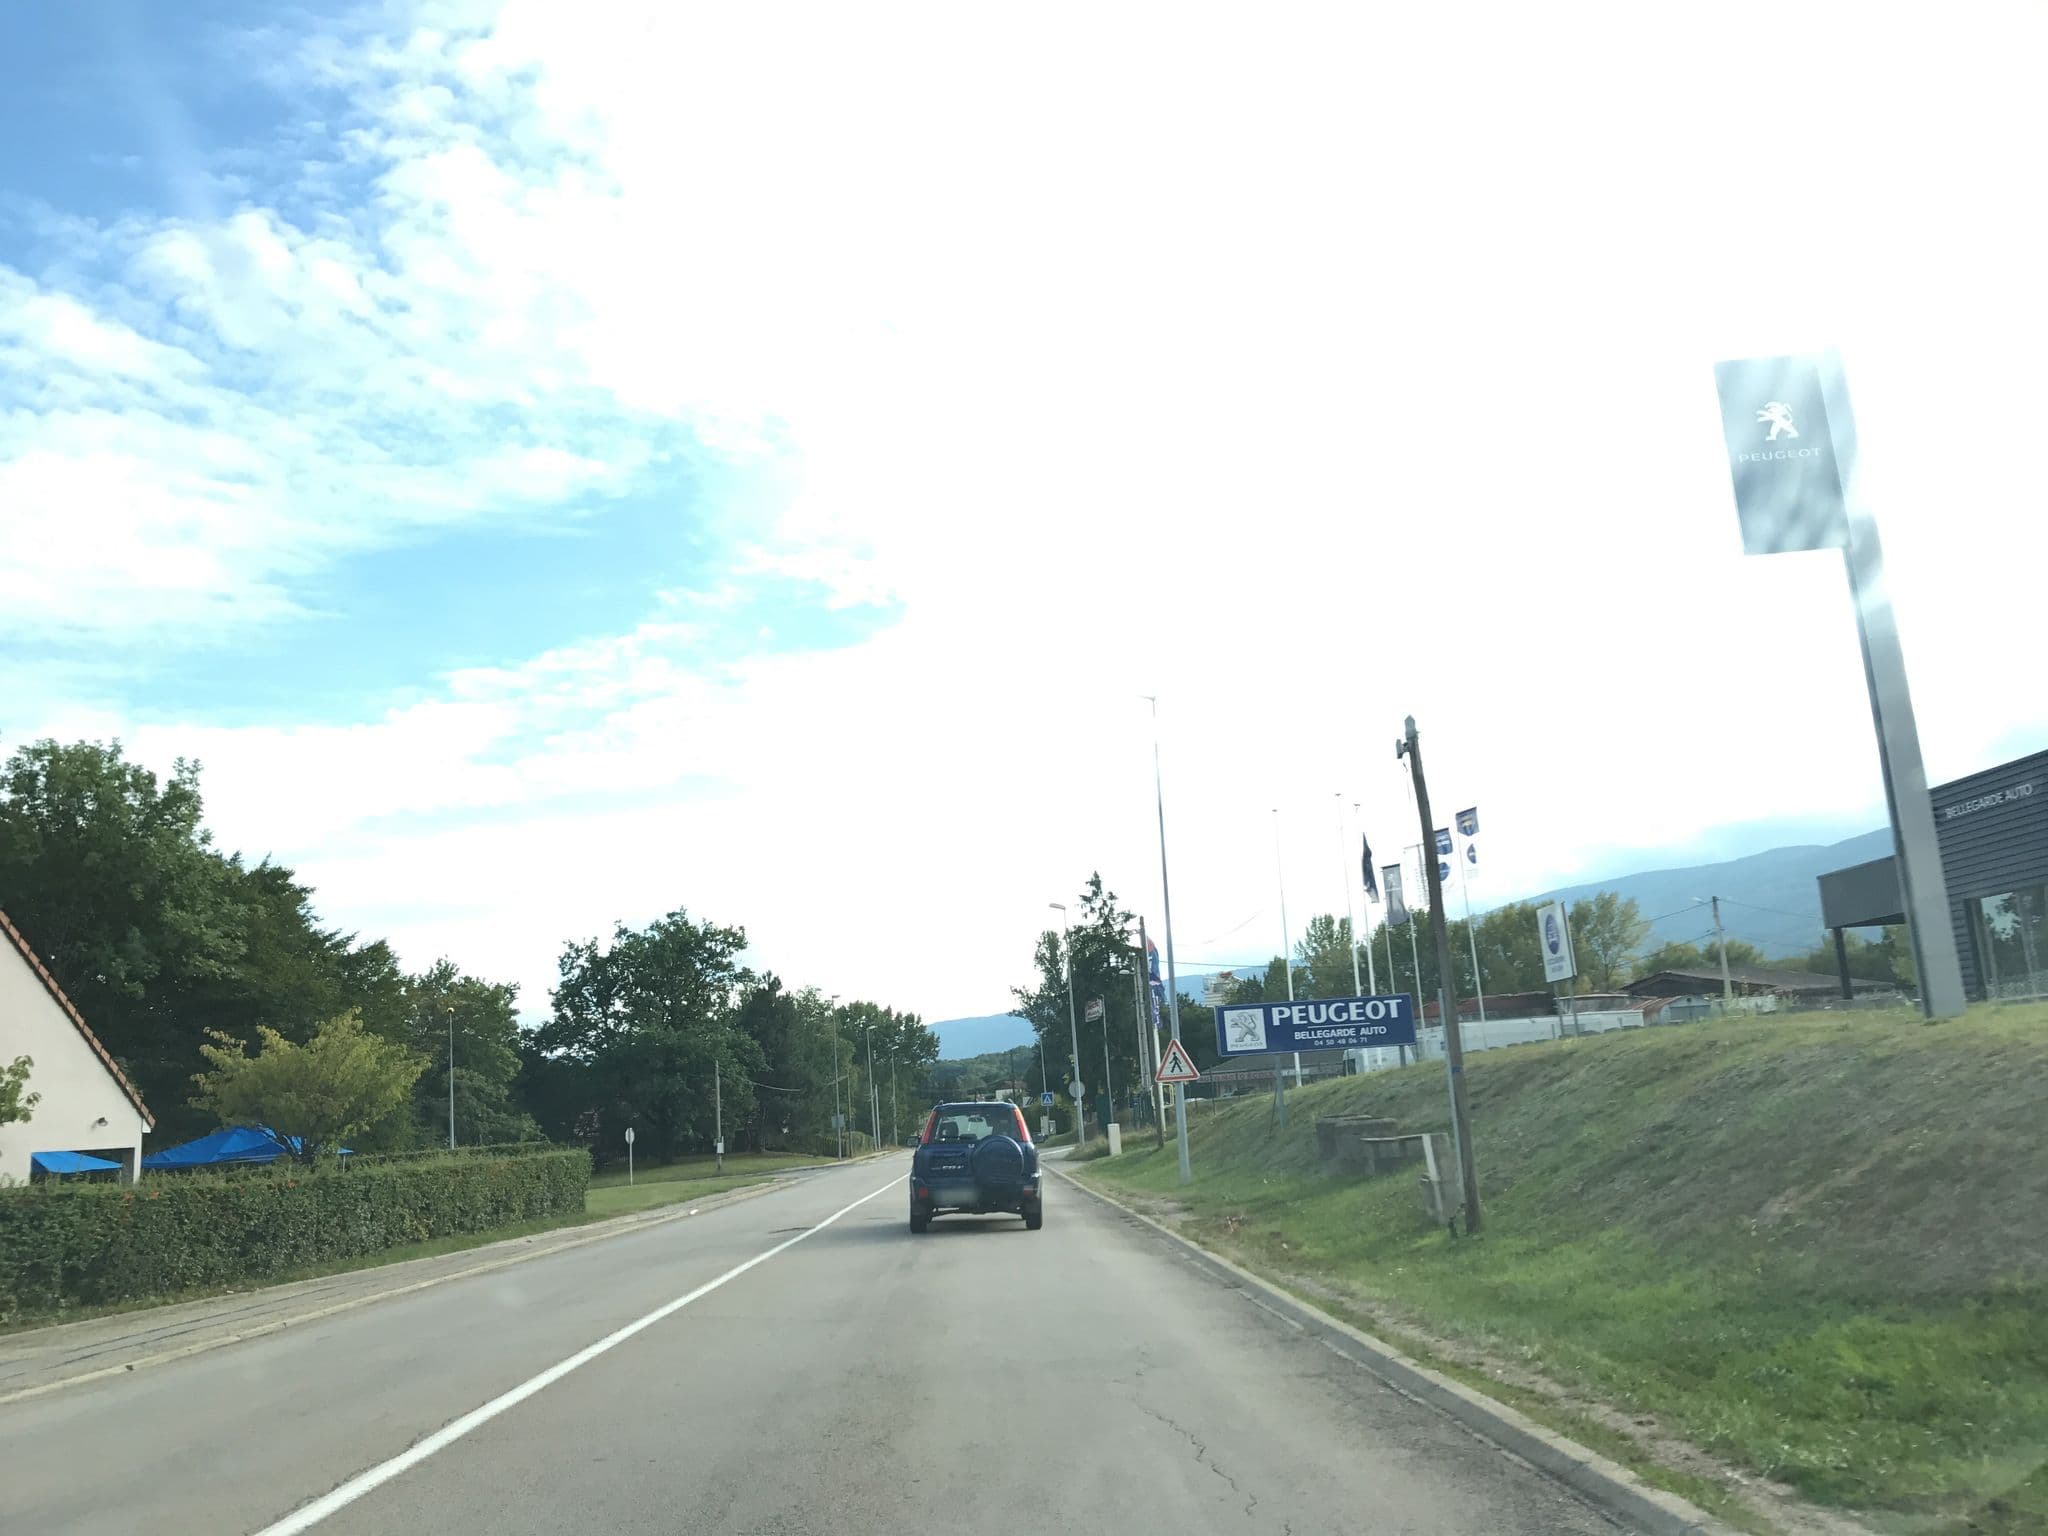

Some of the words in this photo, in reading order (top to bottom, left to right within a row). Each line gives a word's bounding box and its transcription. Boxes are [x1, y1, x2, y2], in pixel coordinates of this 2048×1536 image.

[1738, 447, 1822, 464] PEUGEOT
[1944, 792, 2004, 819] BELLEGARDE
[2005, 783, 2033, 800] AUTO
[1271, 999, 1403, 1026] PEUGEOT
[1294, 1028, 1357, 1040] BELLEGARDE
[1360, 1025, 1387, 1036] AUTO
